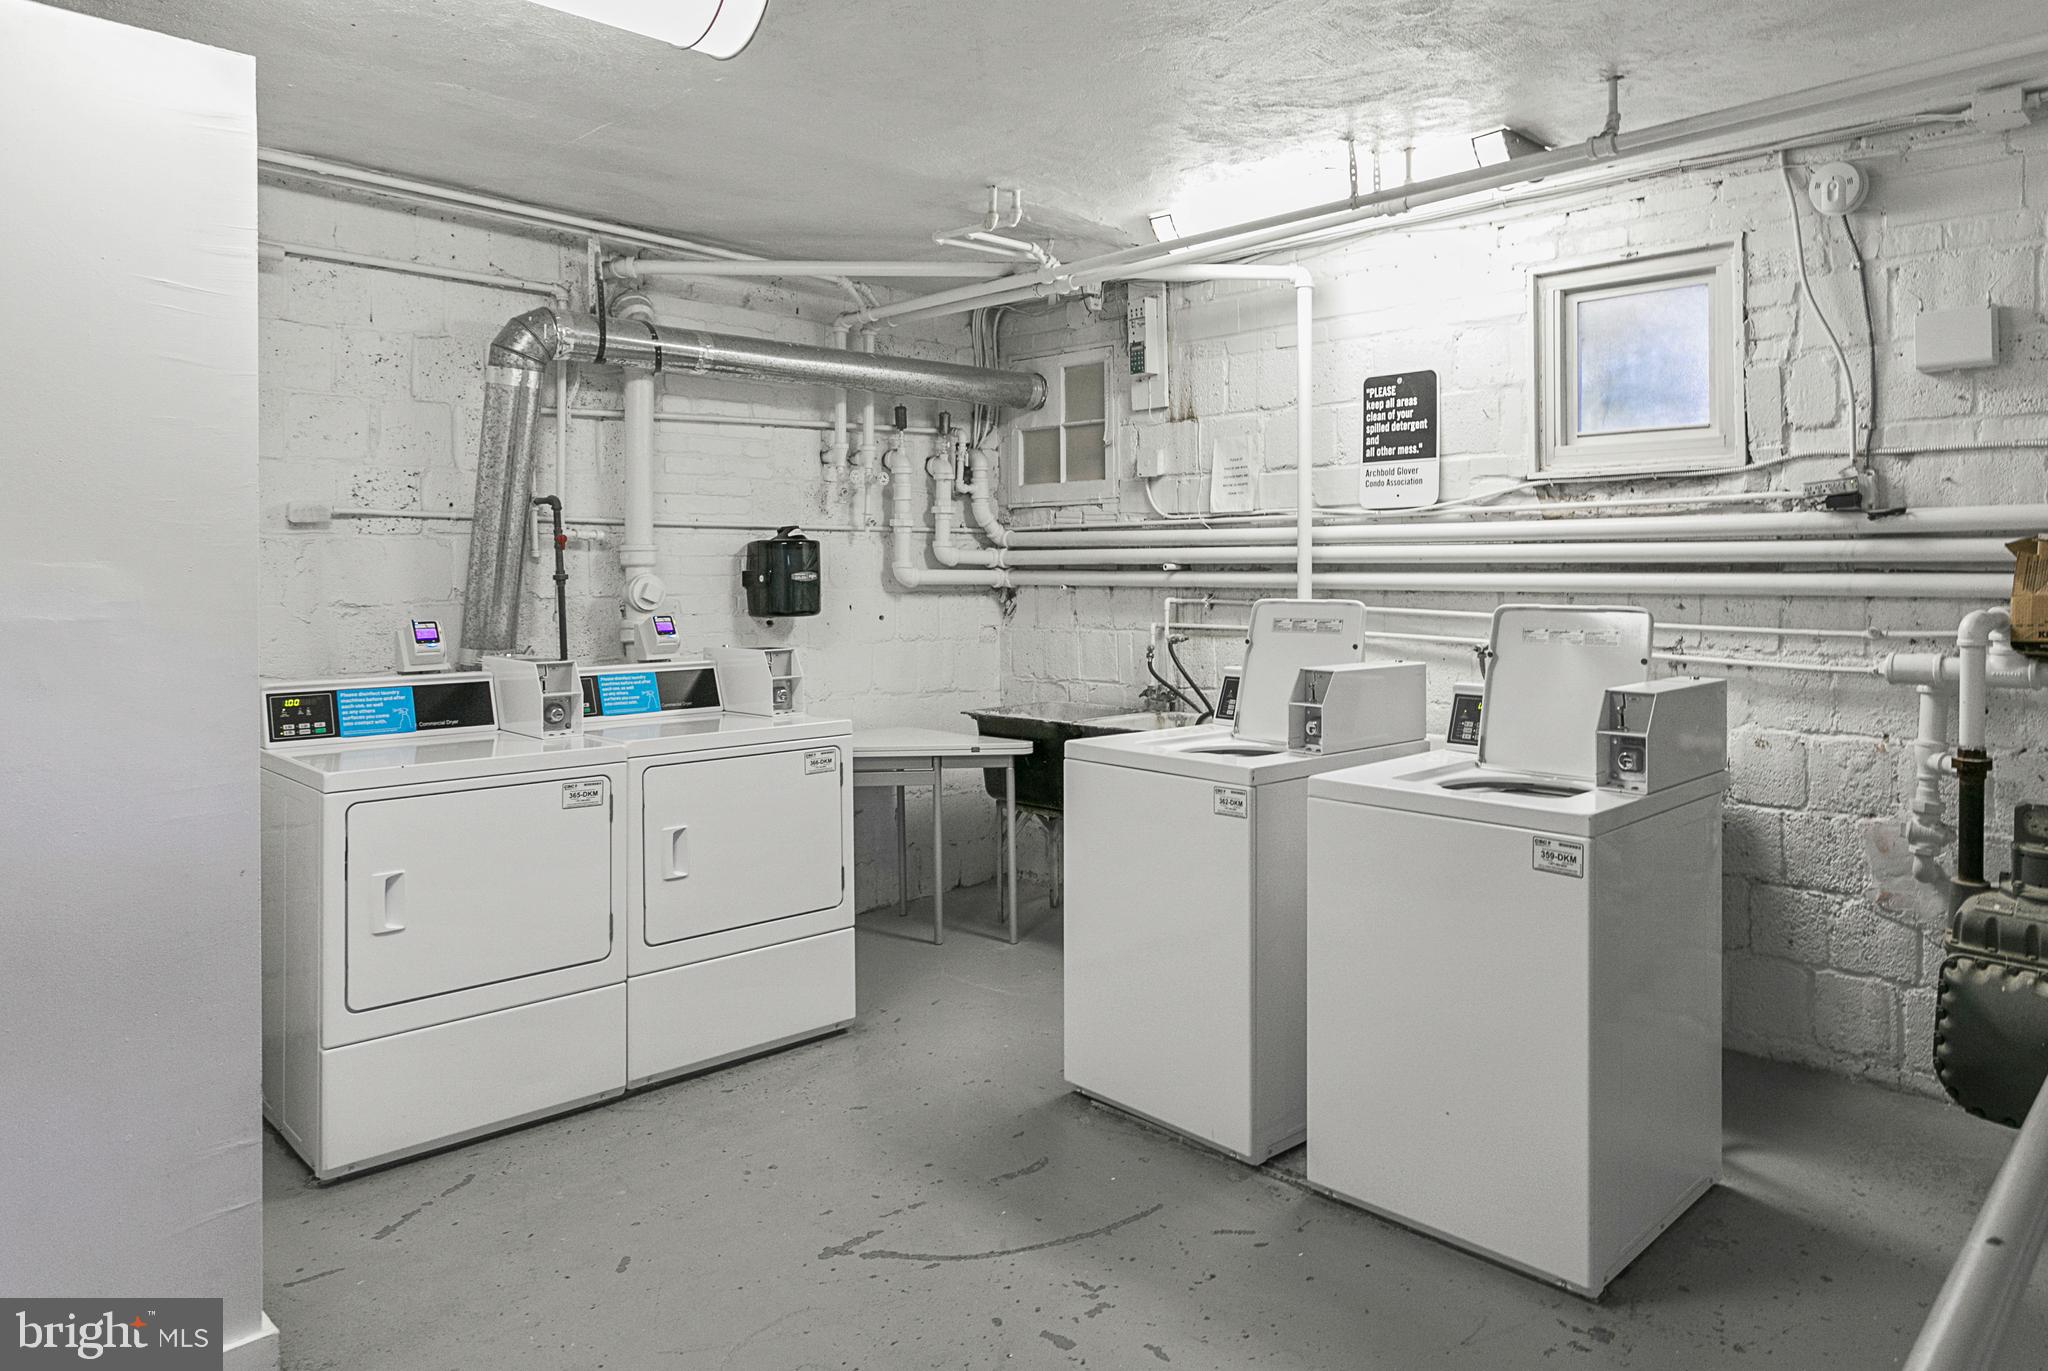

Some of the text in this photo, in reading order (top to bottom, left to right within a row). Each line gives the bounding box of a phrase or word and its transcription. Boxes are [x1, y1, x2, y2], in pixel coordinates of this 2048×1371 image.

[1366, 385, 1396, 399] "PLEASE
[1366, 397, 1418, 411] keep all areas
[1366, 409, 1414, 422] clean of your
[1366, 418, 1428, 435] spilled detergent
[1366, 435, 1380, 446] and
[1366, 442, 1423, 457] all other mess."
[1365, 466, 1419, 478] Archbold Glover
[1365, 477, 1423, 488] Condo Association
[569, 790, 598, 799] 365-DKM
[1541, 850, 1577, 864] 359-DKM
